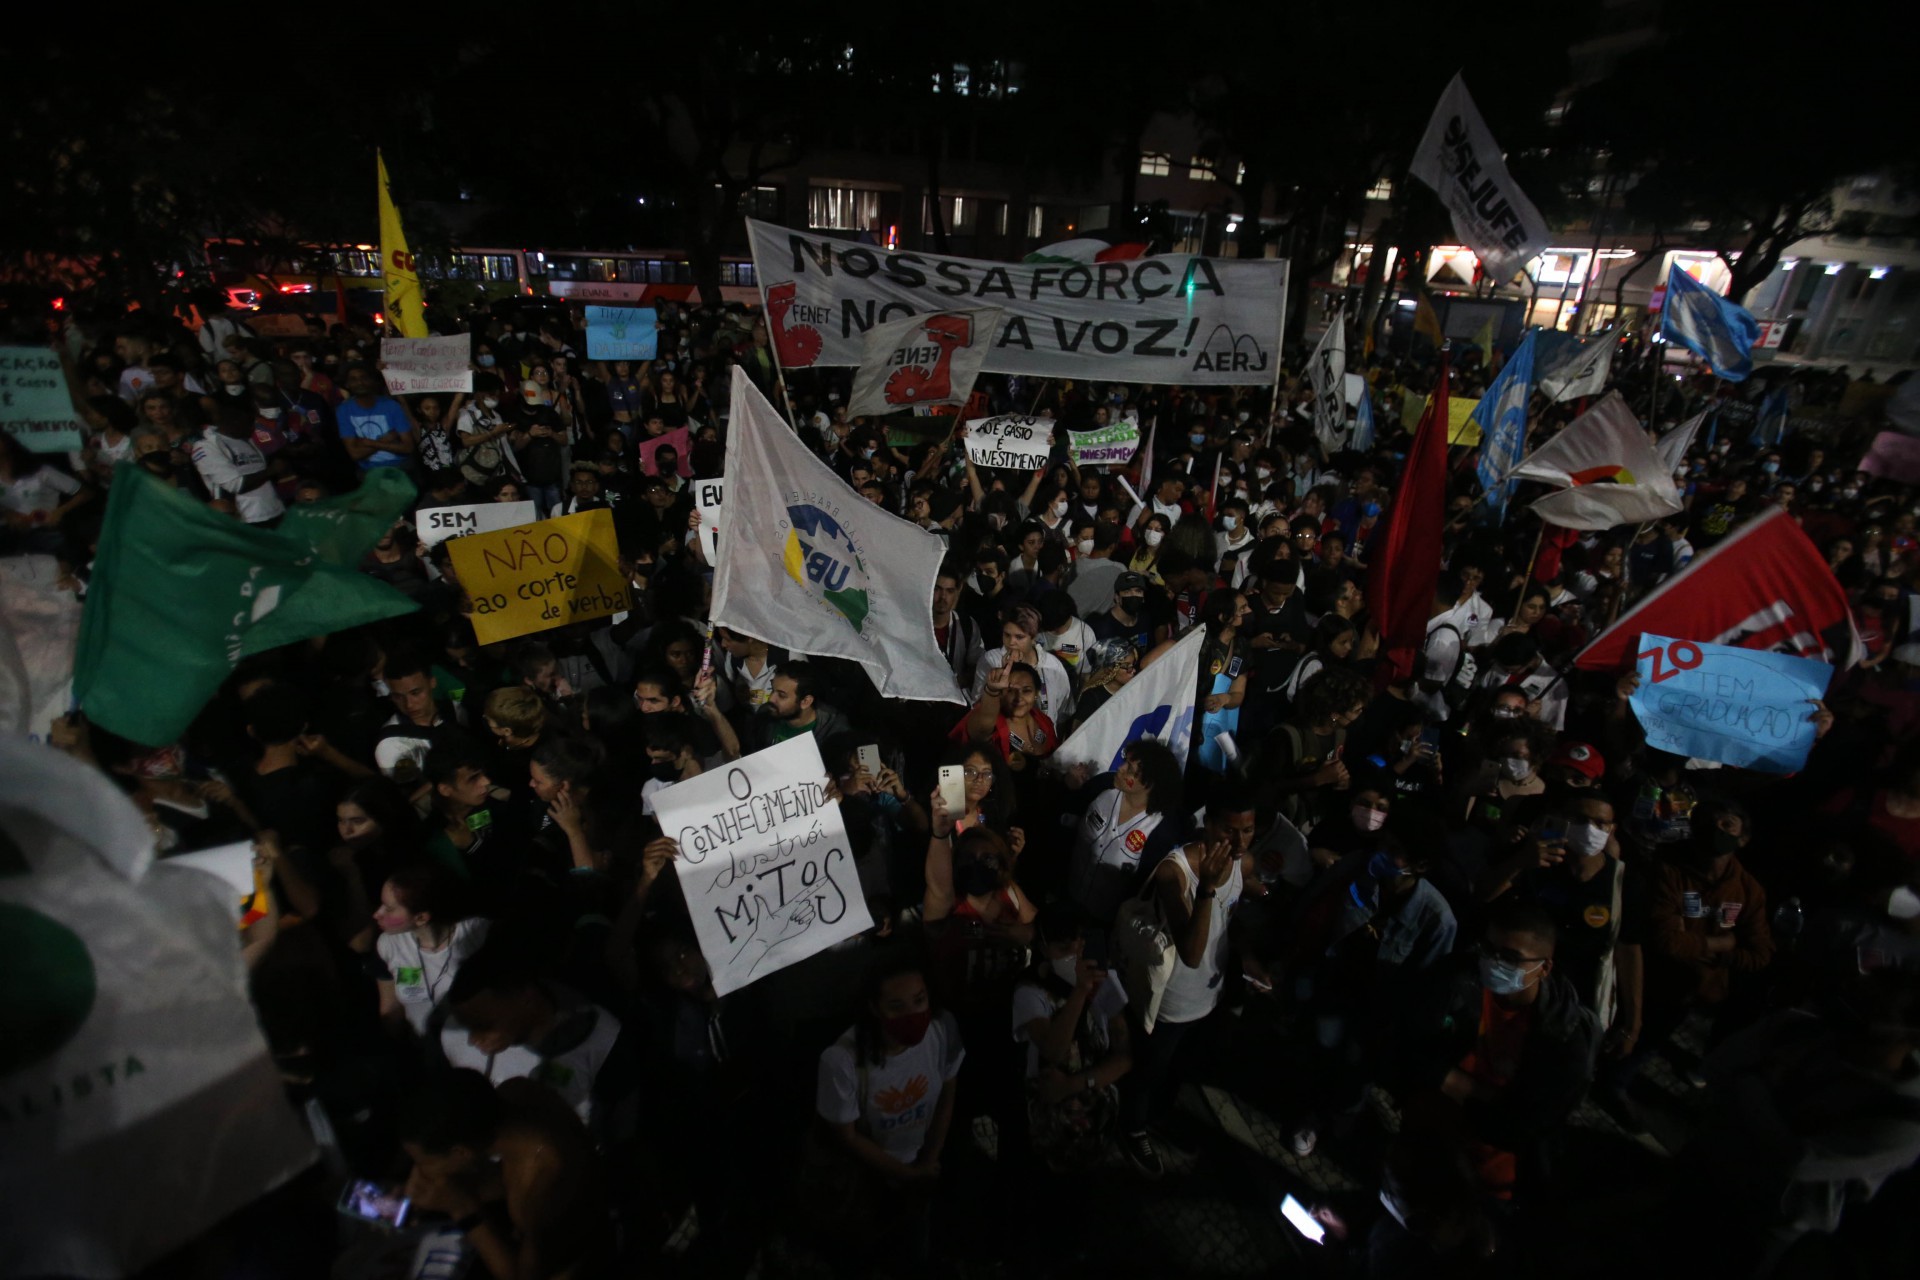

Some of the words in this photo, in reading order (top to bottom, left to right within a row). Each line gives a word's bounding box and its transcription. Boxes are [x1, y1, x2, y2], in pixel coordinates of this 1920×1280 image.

[788, 234, 1016, 299] NOSSA
[1030, 258, 1225, 304] FORÇA
[792, 304, 831, 324] FENET
[1052, 316, 1200, 357] VOZ!
[1192, 351, 1268, 372] AERJ
[1320, 348, 1344, 434] AERJ
[1004, 425, 1033, 440] GASTO
[429, 511, 478, 529] SEM
[482, 529, 569, 578] NÃO
[476, 593, 508, 615] ao
[517, 571, 578, 601] corte
[540, 599, 561, 621] de
[1699, 671, 1755, 701] TEM
[728, 767, 752, 801] O
